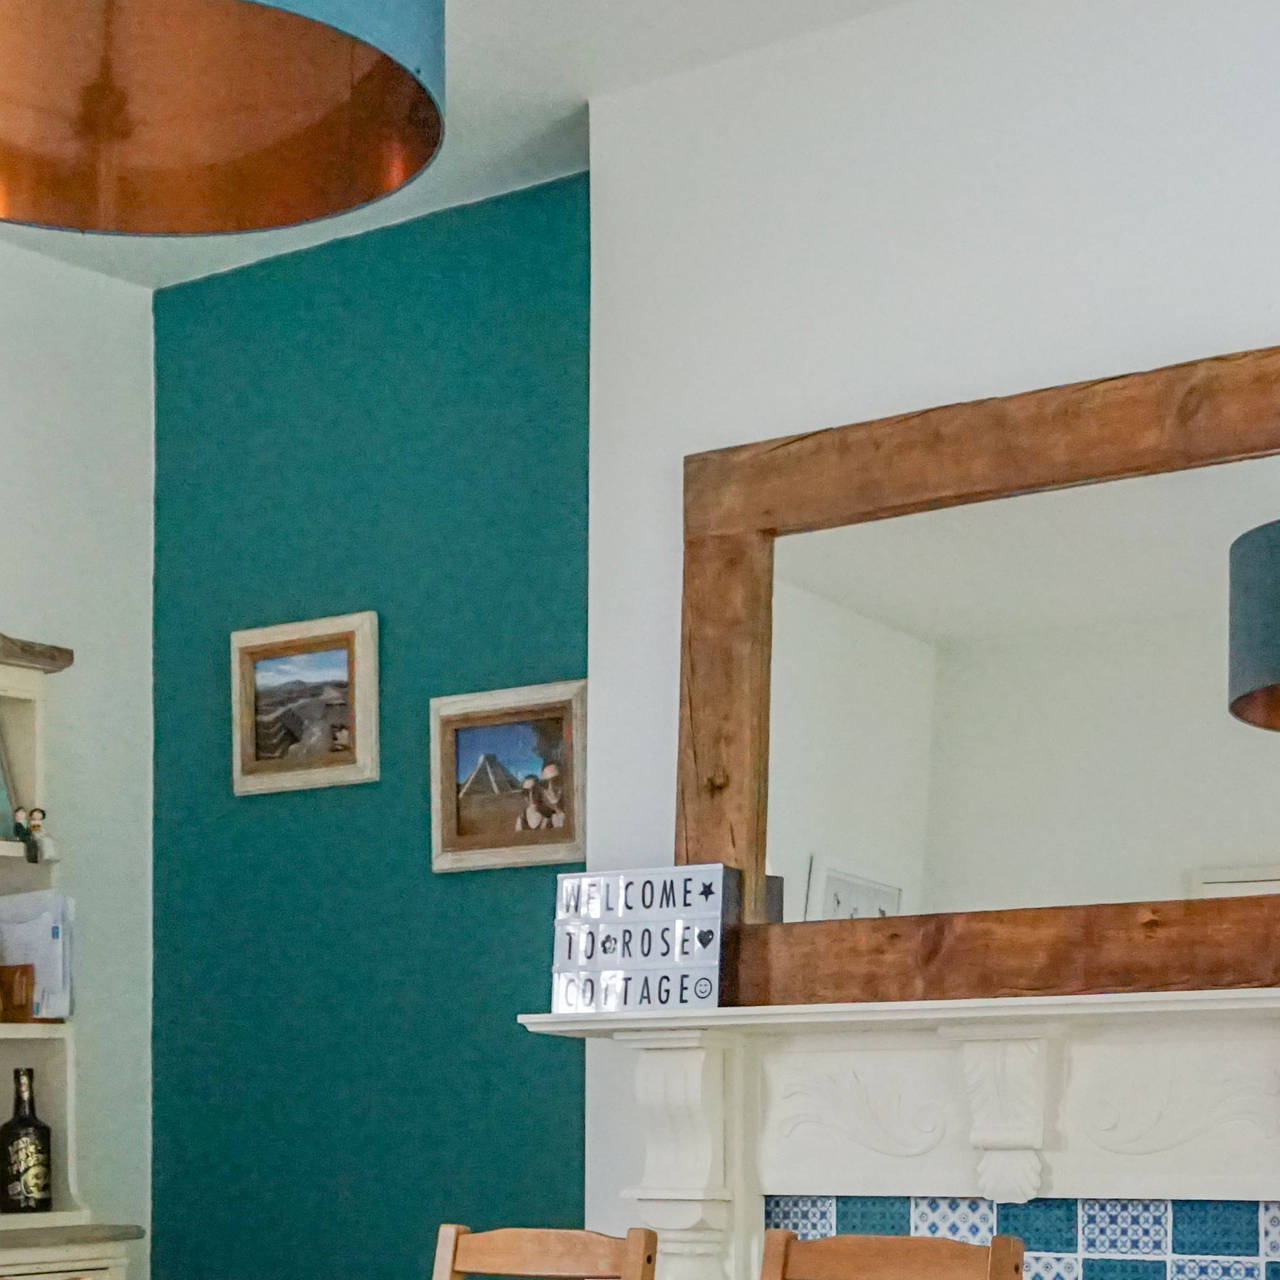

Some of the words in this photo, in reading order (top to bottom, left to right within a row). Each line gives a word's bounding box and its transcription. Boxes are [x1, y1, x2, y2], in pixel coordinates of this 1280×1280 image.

[565, 878, 693, 913] WELCOME
[566, 930, 596, 960] TO
[622, 926, 691, 958] ROSE
